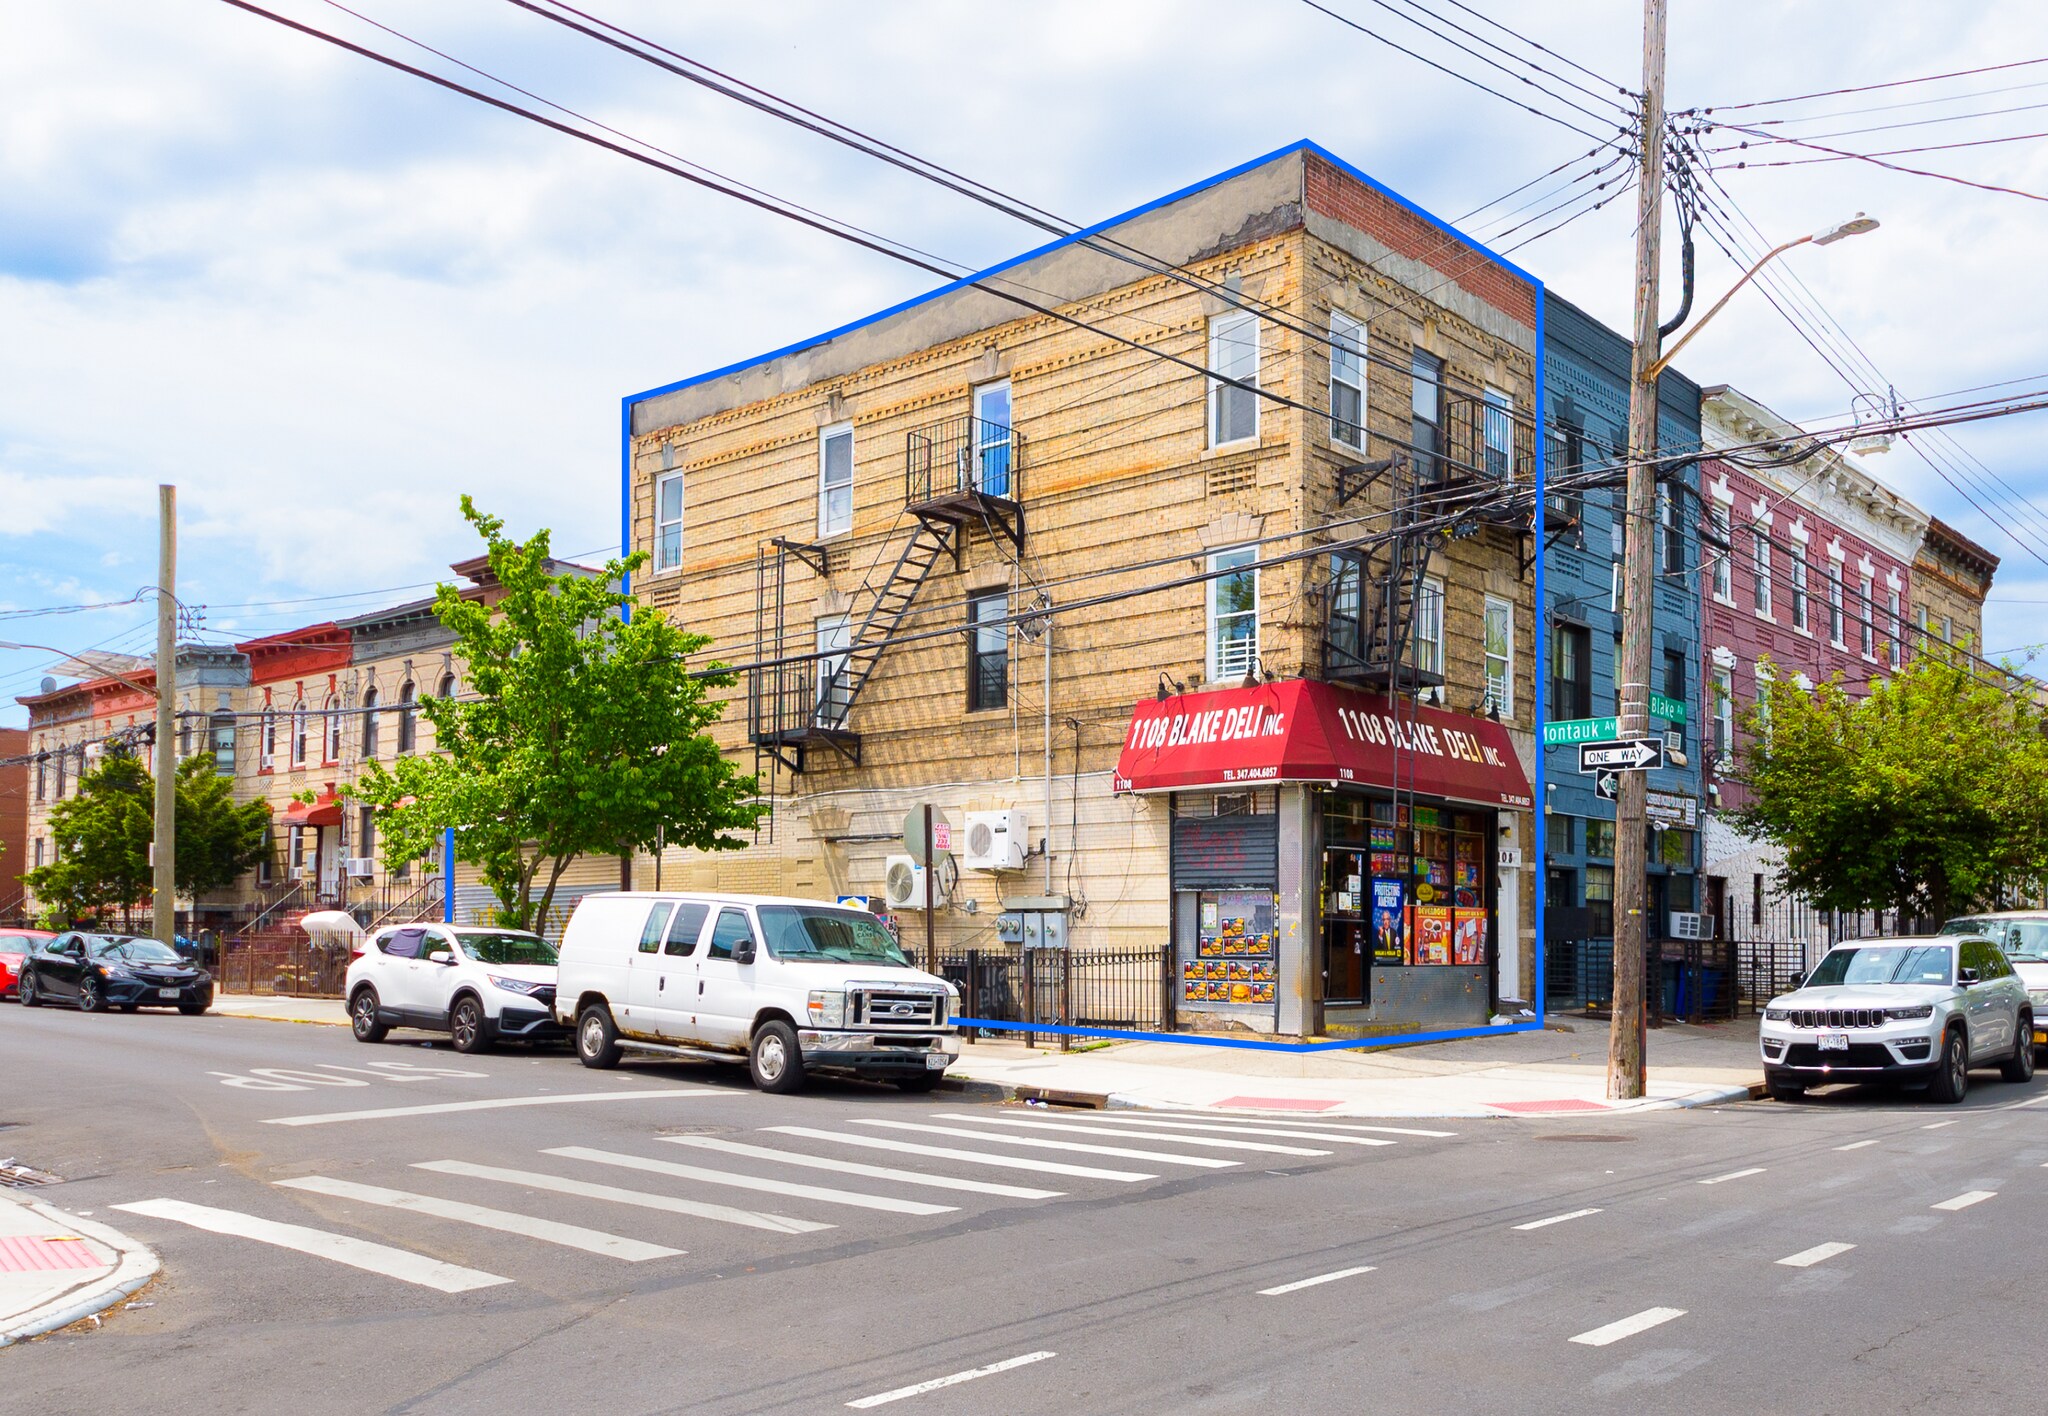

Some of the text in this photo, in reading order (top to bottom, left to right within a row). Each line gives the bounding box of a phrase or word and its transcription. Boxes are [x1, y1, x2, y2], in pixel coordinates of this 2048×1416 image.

[1651, 697, 1684, 718] Blake Av
[1130, 704, 1284, 749] 1108 BLAKE DELI INC.
[1604, 721, 1616, 731] Av
[1338, 707, 1506, 767] 1108 BLAKE DELI INC.
[1589, 749, 1643, 763] ONE WAY
[1223, 770, 1236, 781] TEL.
[1340, 768, 1353, 779] 1108
[1116, 779, 1132, 790] 1108
[1604, 777, 1617, 791] ONE
[1374, 884, 1400, 897] PROTECTING
[1378, 895, 1397, 907] AMERICA
[205, 1061, 490, 1091] STOP
